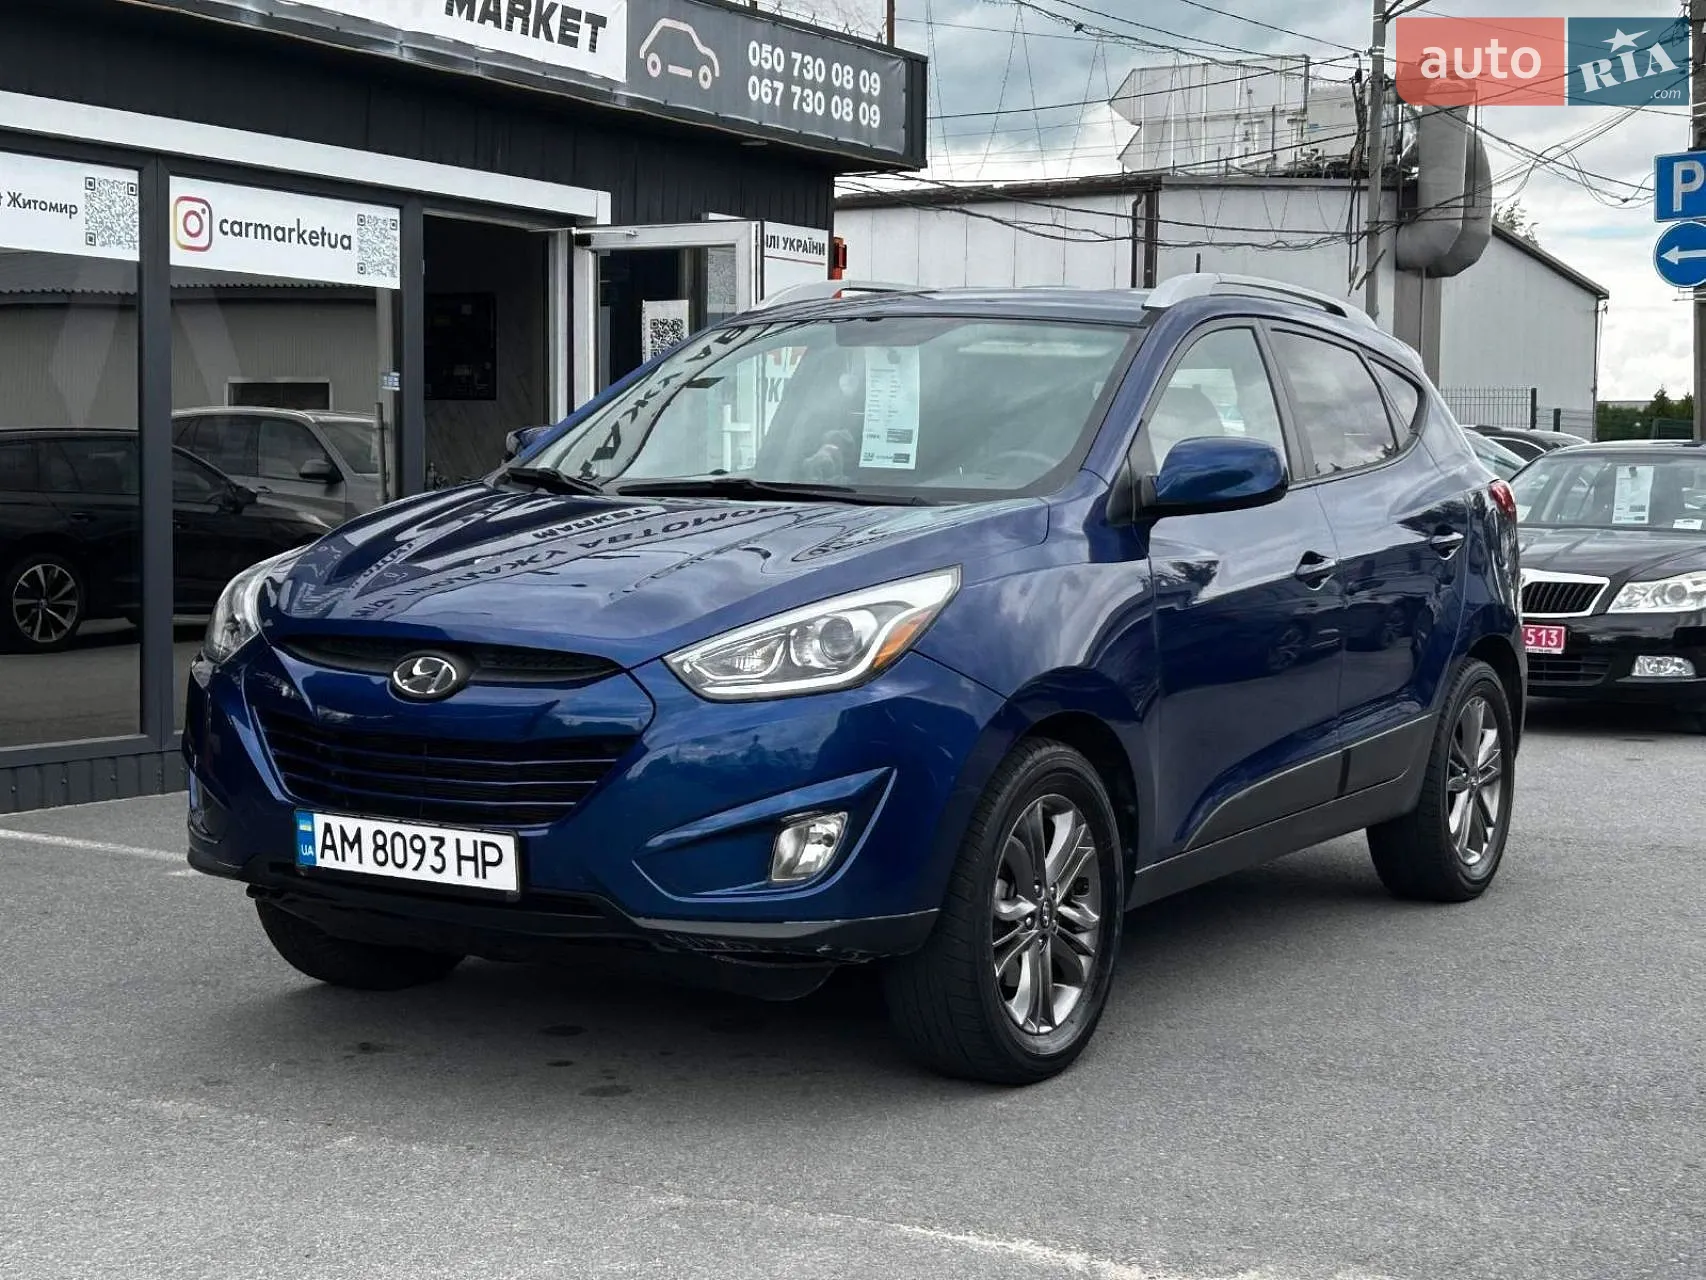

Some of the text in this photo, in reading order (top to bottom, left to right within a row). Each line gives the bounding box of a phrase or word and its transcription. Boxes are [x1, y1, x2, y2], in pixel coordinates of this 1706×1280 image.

[747, 40, 881, 97] 050 730 08 09
[747, 75, 881, 129] 067 730 08 09
[1673, 160, 1705, 212] P
[7, 191, 79, 220] Житомир
[219, 218, 353, 251] carmarketua
[782, 236, 826, 257] УКРАЇНИ
[1523, 628, 1559, 647] 513
[301, 844, 315, 856] UA
[319, 822, 504, 880] AM 8093 HP
